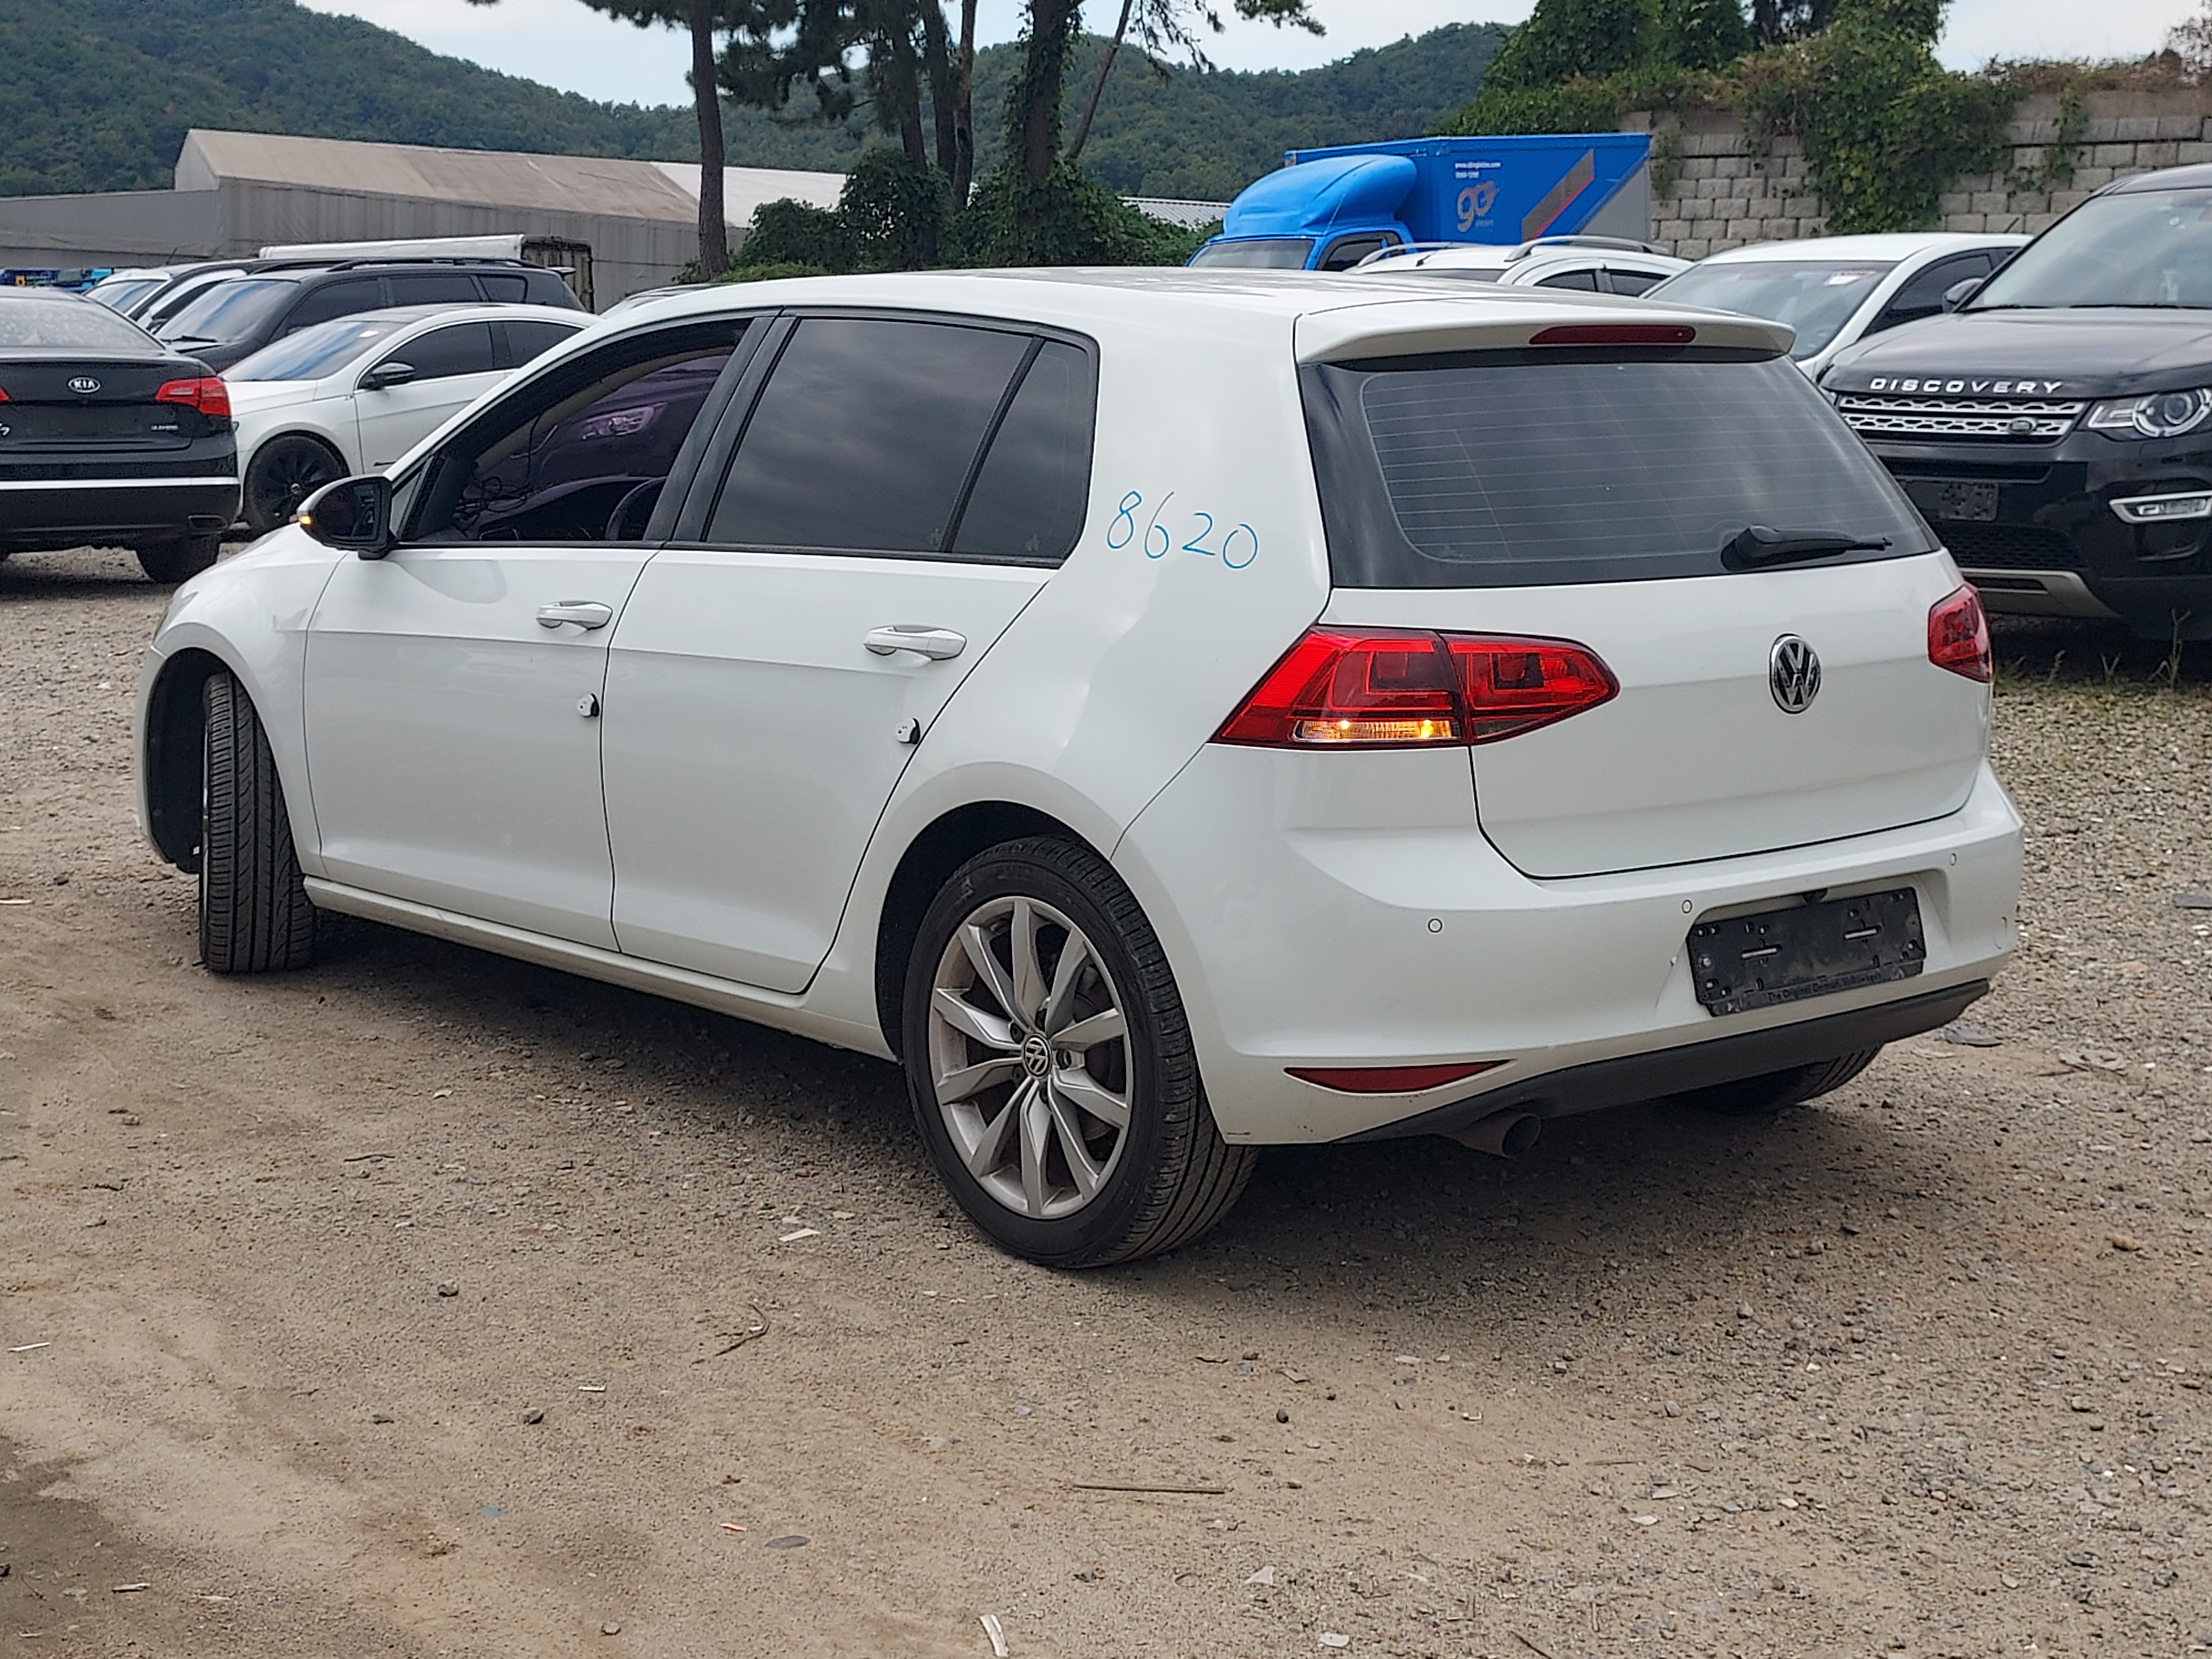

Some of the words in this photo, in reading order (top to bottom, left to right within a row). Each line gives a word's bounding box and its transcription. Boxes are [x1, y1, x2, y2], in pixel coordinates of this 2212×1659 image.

[74, 379, 96, 389] KIA
[1870, 378, 2062, 393] DISCOVERY
[1107, 491, 1258, 568] 8620
